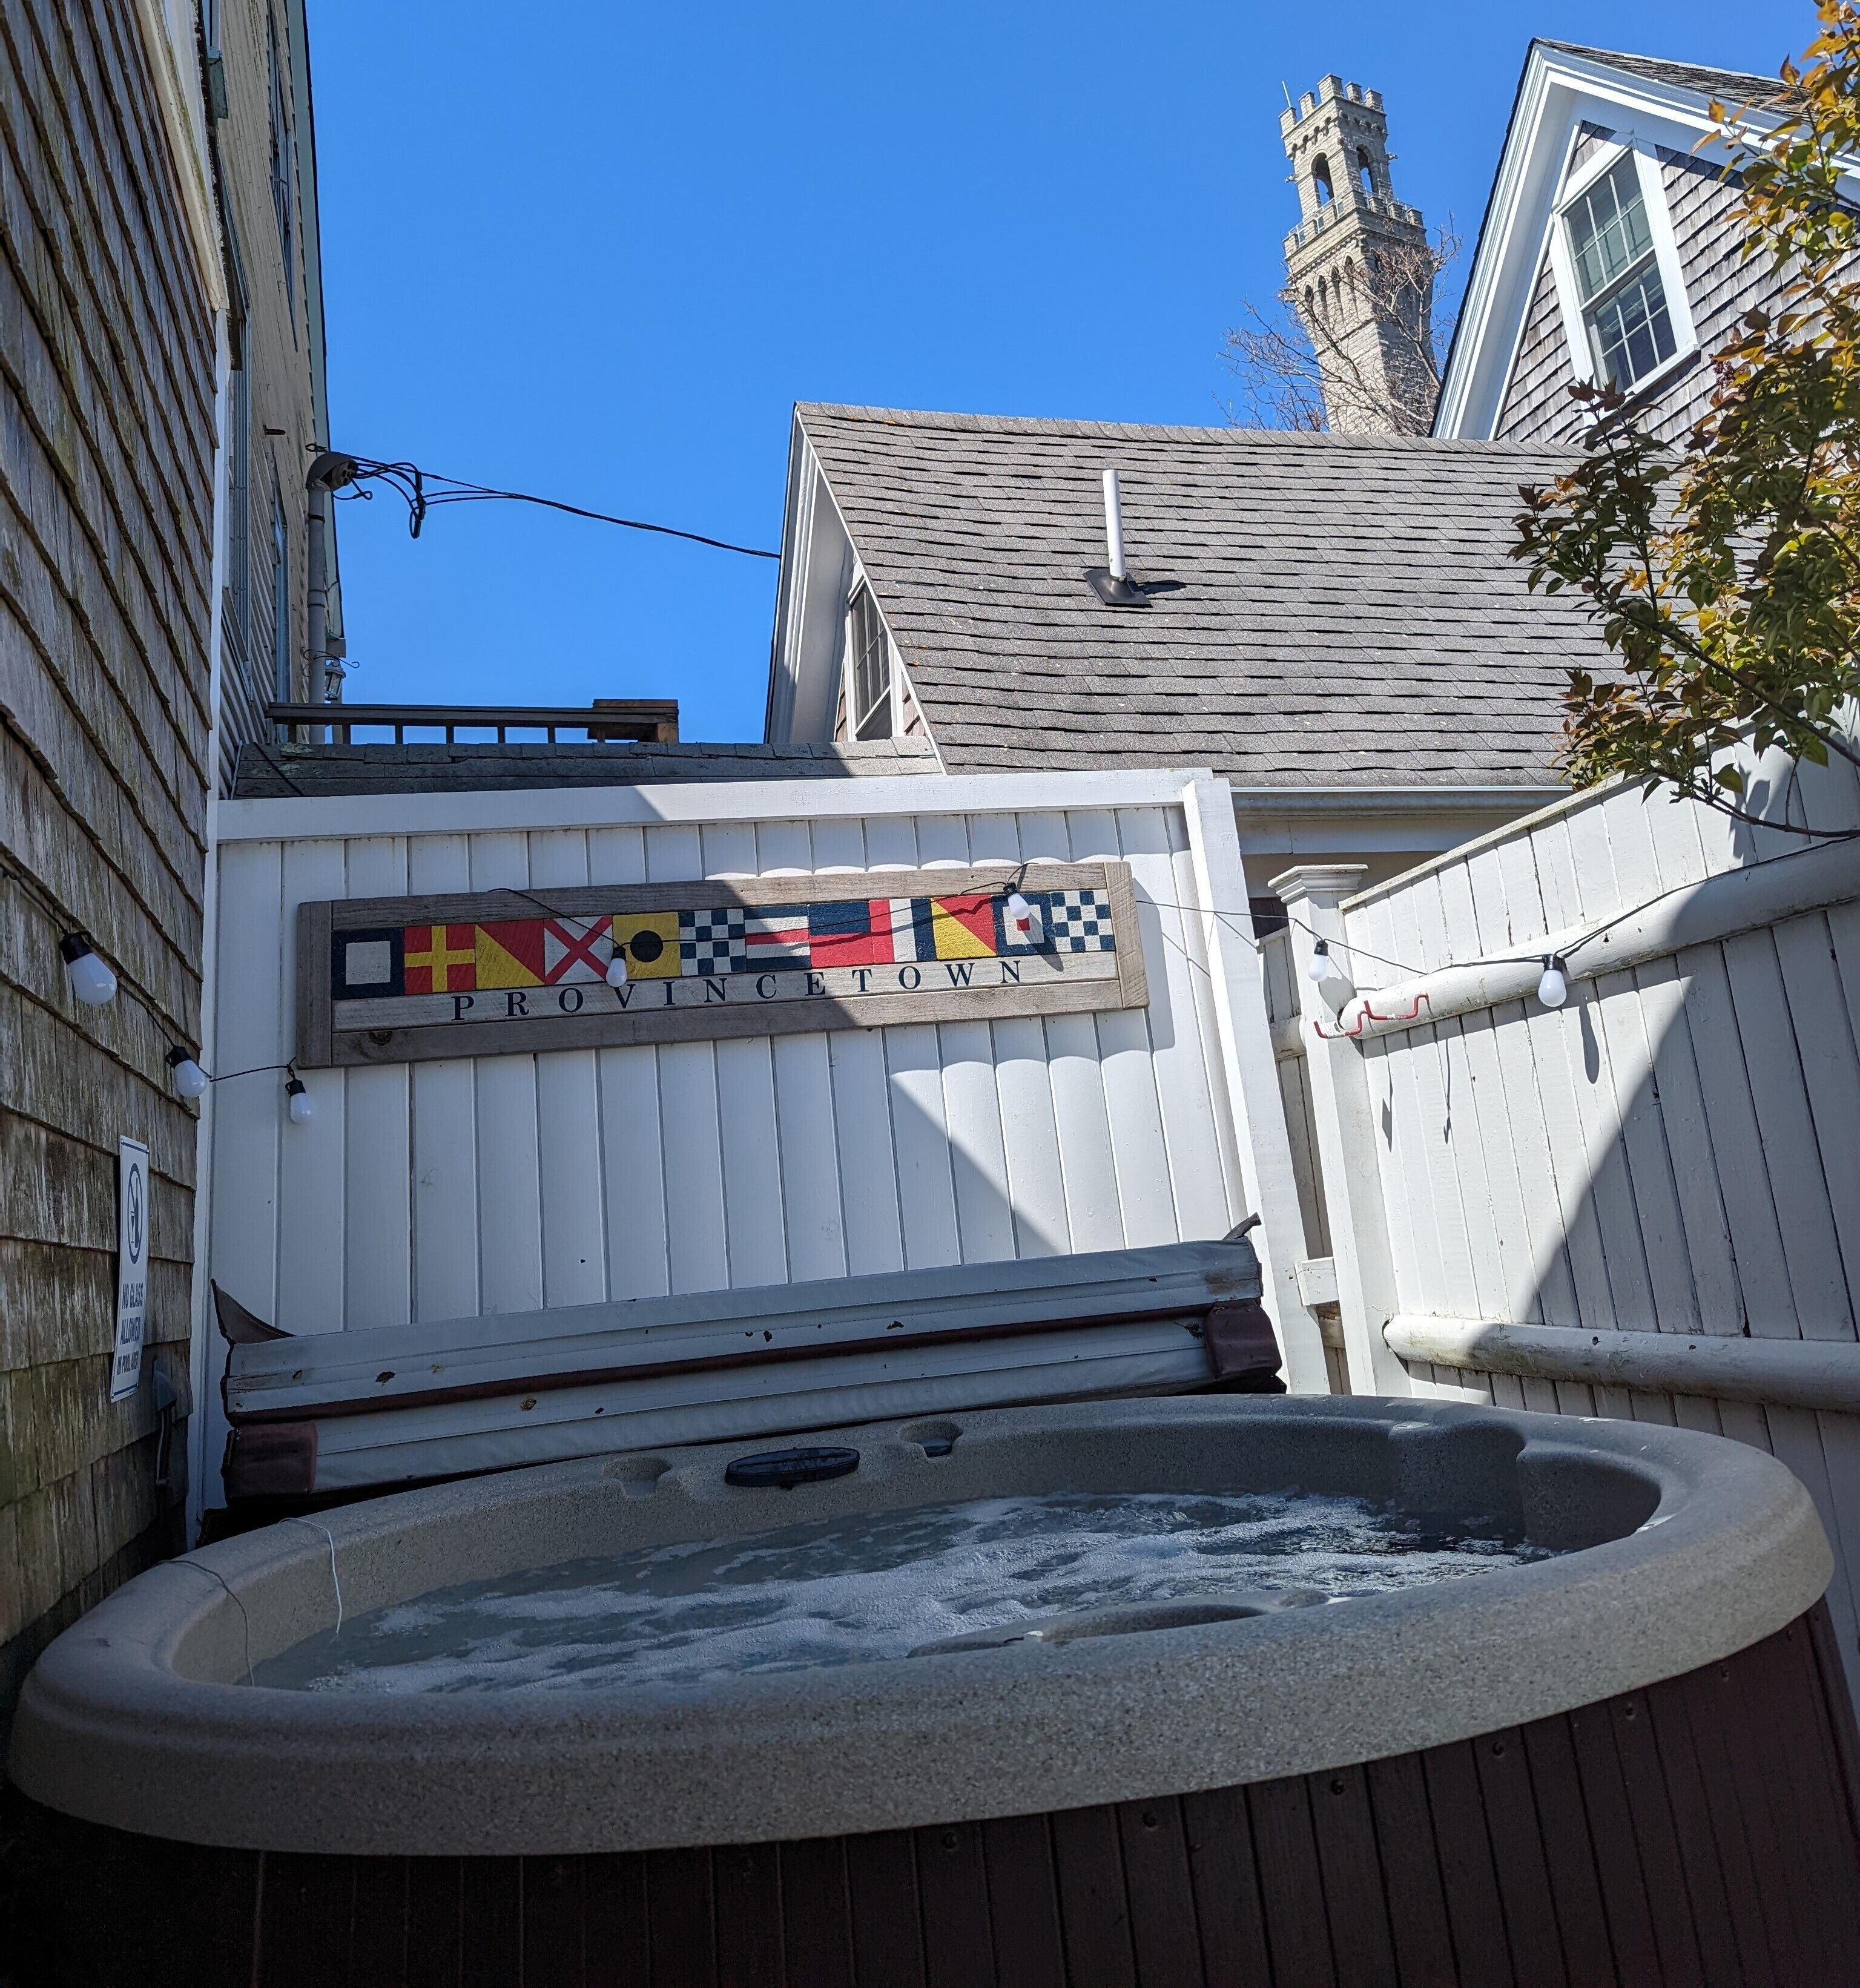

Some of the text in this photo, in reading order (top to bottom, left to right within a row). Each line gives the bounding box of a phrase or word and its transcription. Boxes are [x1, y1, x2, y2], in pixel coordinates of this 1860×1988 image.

[450, 959, 1021, 1021] PROVINCETOWN
[122, 1283, 143, 1309] NO GLASS
[120, 1317, 140, 1345] ALLOWED
[117, 1356, 122, 1375] IN
[122, 1354, 130, 1374] POOL
